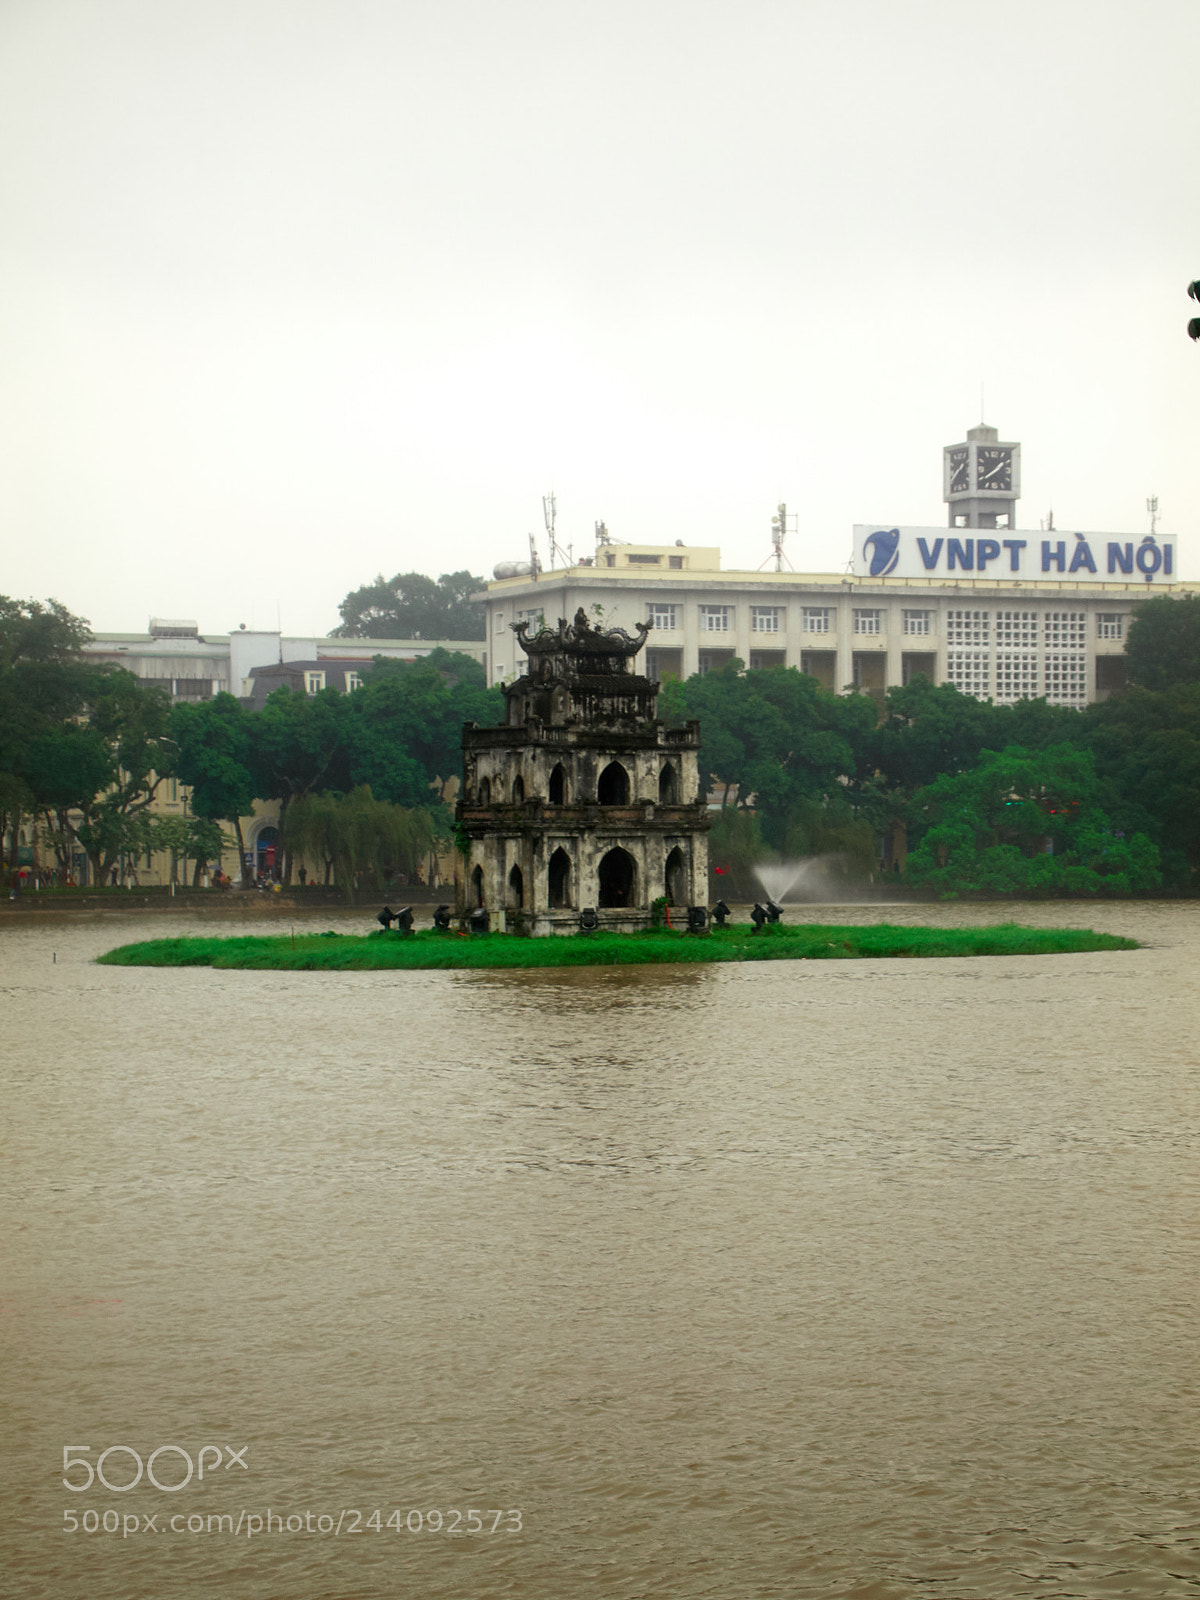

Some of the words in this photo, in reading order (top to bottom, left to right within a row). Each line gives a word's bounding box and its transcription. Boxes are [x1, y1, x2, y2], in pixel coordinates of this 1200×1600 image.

[916, 537, 1027, 571] VNPT
[1041, 533, 1097, 573] HÀ
[1107, 536, 1173, 582] NỘI
